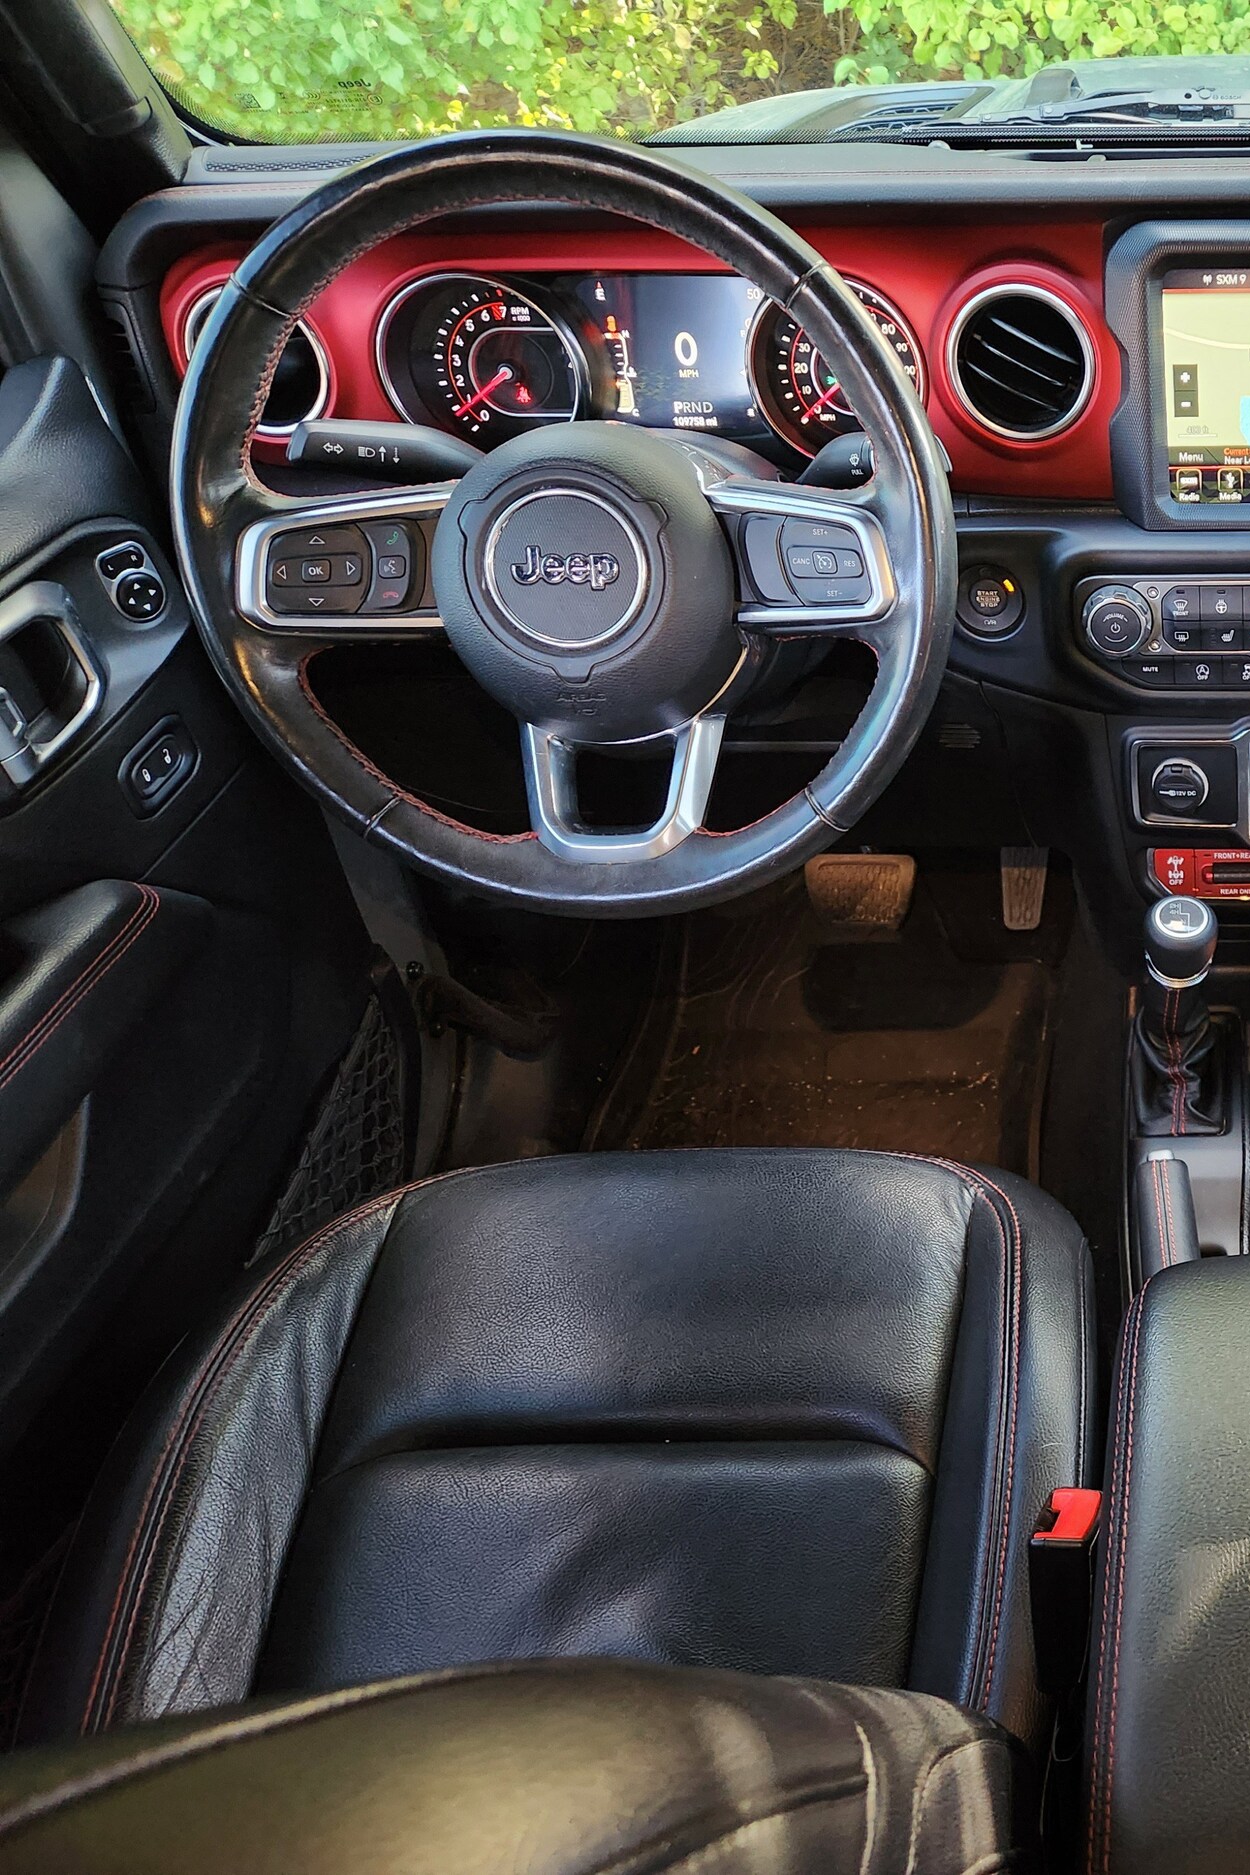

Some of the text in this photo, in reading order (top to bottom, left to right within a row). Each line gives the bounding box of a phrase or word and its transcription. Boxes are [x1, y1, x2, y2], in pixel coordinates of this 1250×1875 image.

[1216, 273, 1247, 285] SXM 9
[481, 310, 490, 322] 6
[499, 306, 507, 318] 7
[511, 306, 529, 315] RPM
[465, 320, 475, 332] 5
[881, 323, 896, 336] 80
[455, 335, 465, 347] 4
[674, 331, 698, 367] 0
[798, 342, 811, 353] 30
[895, 342, 908, 353] 90
[451, 354, 462, 367] 3
[679, 368, 699, 378] MPH
[794, 362, 809, 375] 20
[455, 374, 466, 387] 2
[801, 386, 812, 396] 10
[479, 410, 490, 422] 0
[820, 413, 837, 421] MPH
[1223, 447, 1248, 456] Current
[1178, 452, 1204, 463] Menu
[1224, 455, 1243, 465] Near
[1178, 492, 1200, 502] Radio
[1219, 491, 1243, 502] Media
[130, 554, 138, 562] R
[792, 557, 811, 566] CANC
[843, 559, 856, 568] RES
[308, 566, 324, 576] OK
[510, 545, 620, 591] Jeep
[1106, 612, 1124, 620] VOLUME
[1176, 789, 1197, 797] 12V DC
[1168, 878, 1184, 886] OFF
